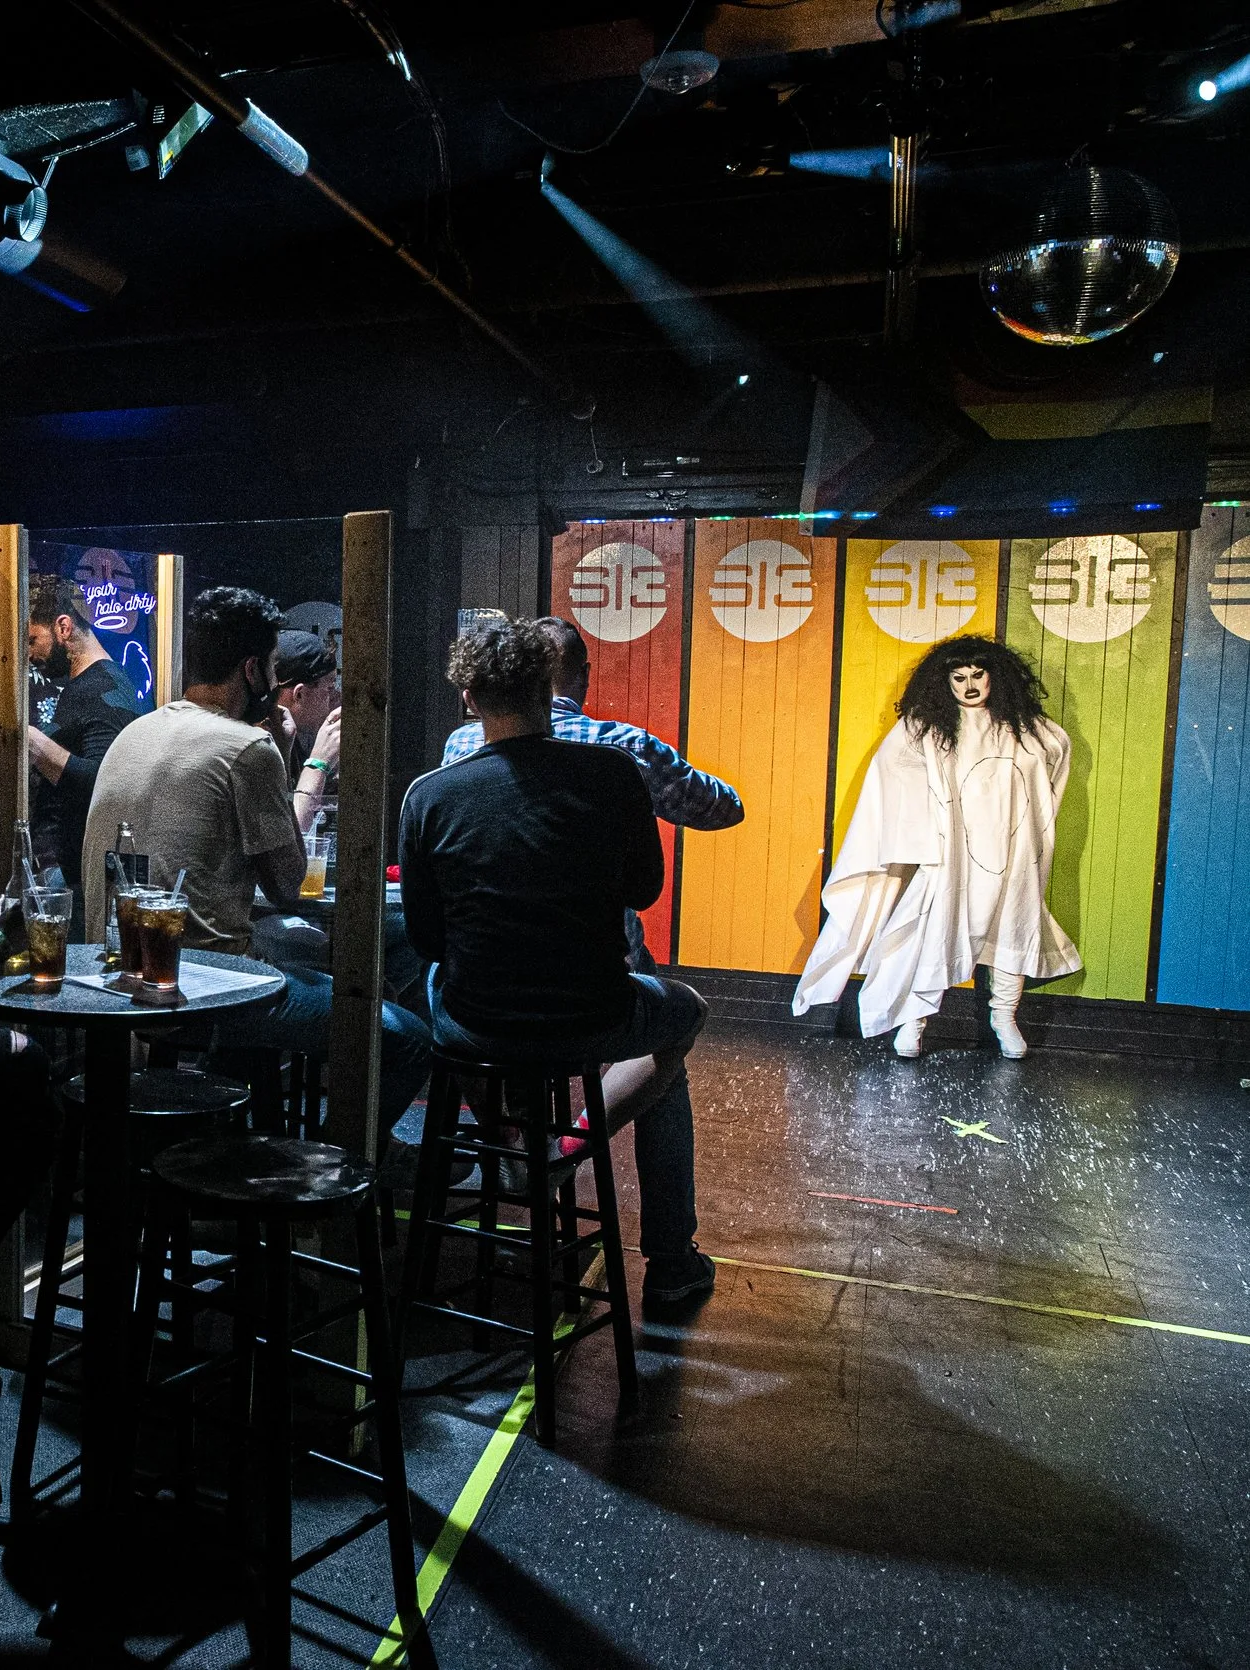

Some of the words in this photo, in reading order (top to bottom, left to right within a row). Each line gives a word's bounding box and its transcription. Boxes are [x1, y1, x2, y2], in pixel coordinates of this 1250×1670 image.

[87, 583, 117, 604] your
[95, 599, 123, 617] halo
[125, 593, 156, 614] dirty
